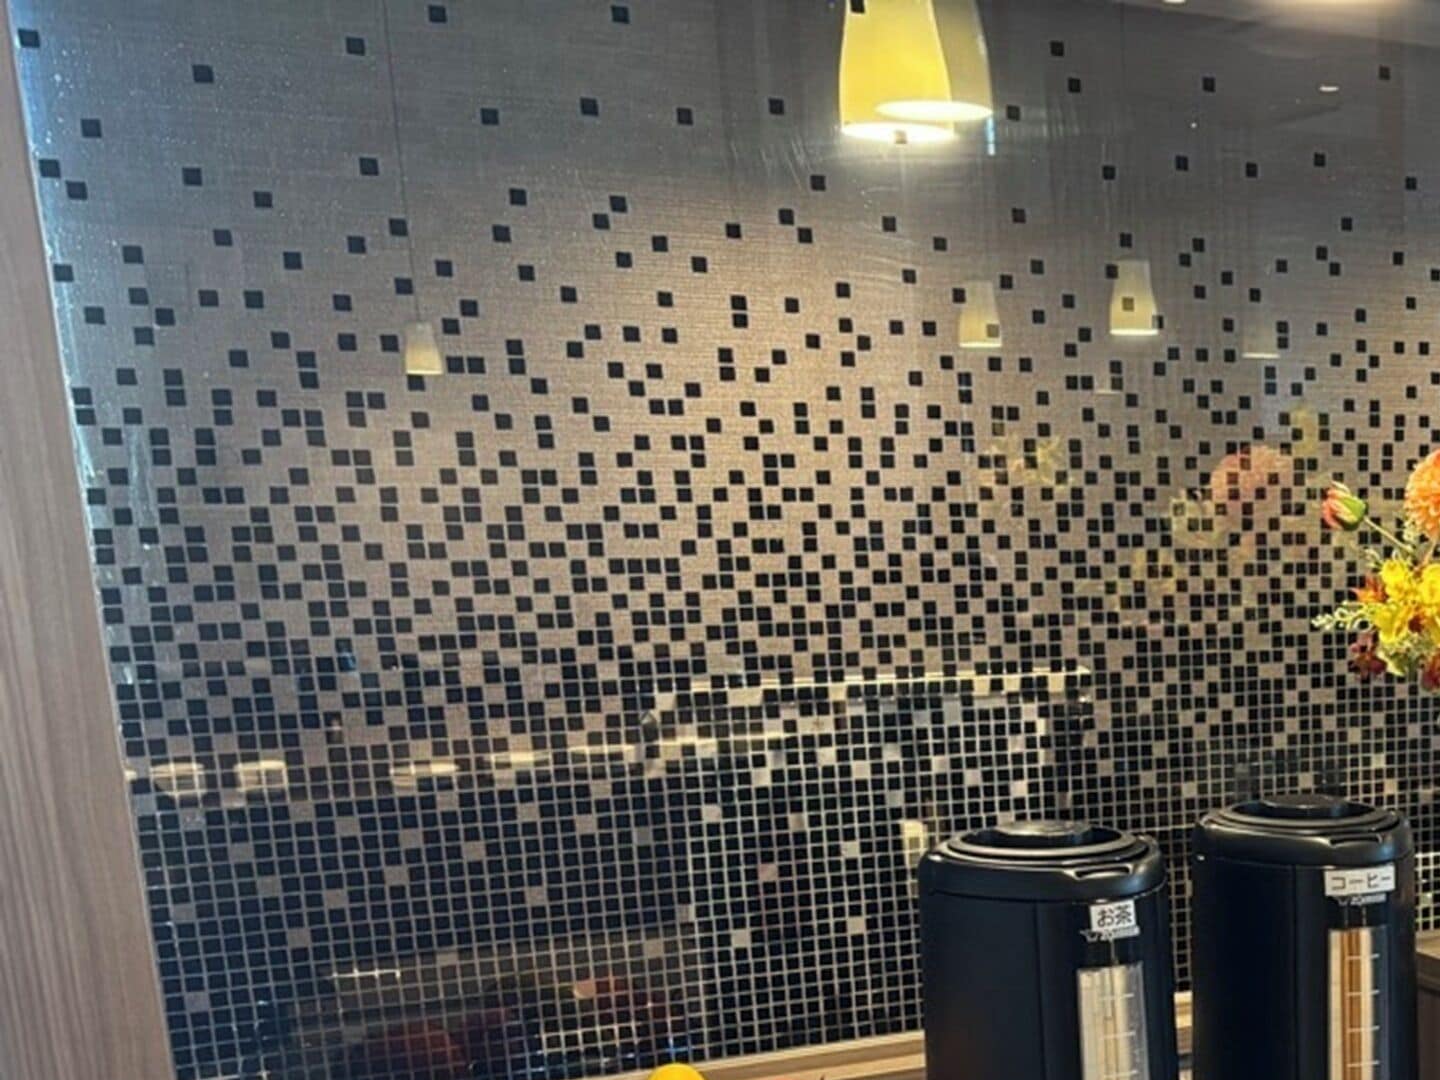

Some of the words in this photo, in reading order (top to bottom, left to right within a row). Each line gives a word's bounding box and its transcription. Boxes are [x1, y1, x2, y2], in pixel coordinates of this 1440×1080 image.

[1330, 871, 1392, 892] コーヒー
[1096, 903, 1133, 928] お茶
